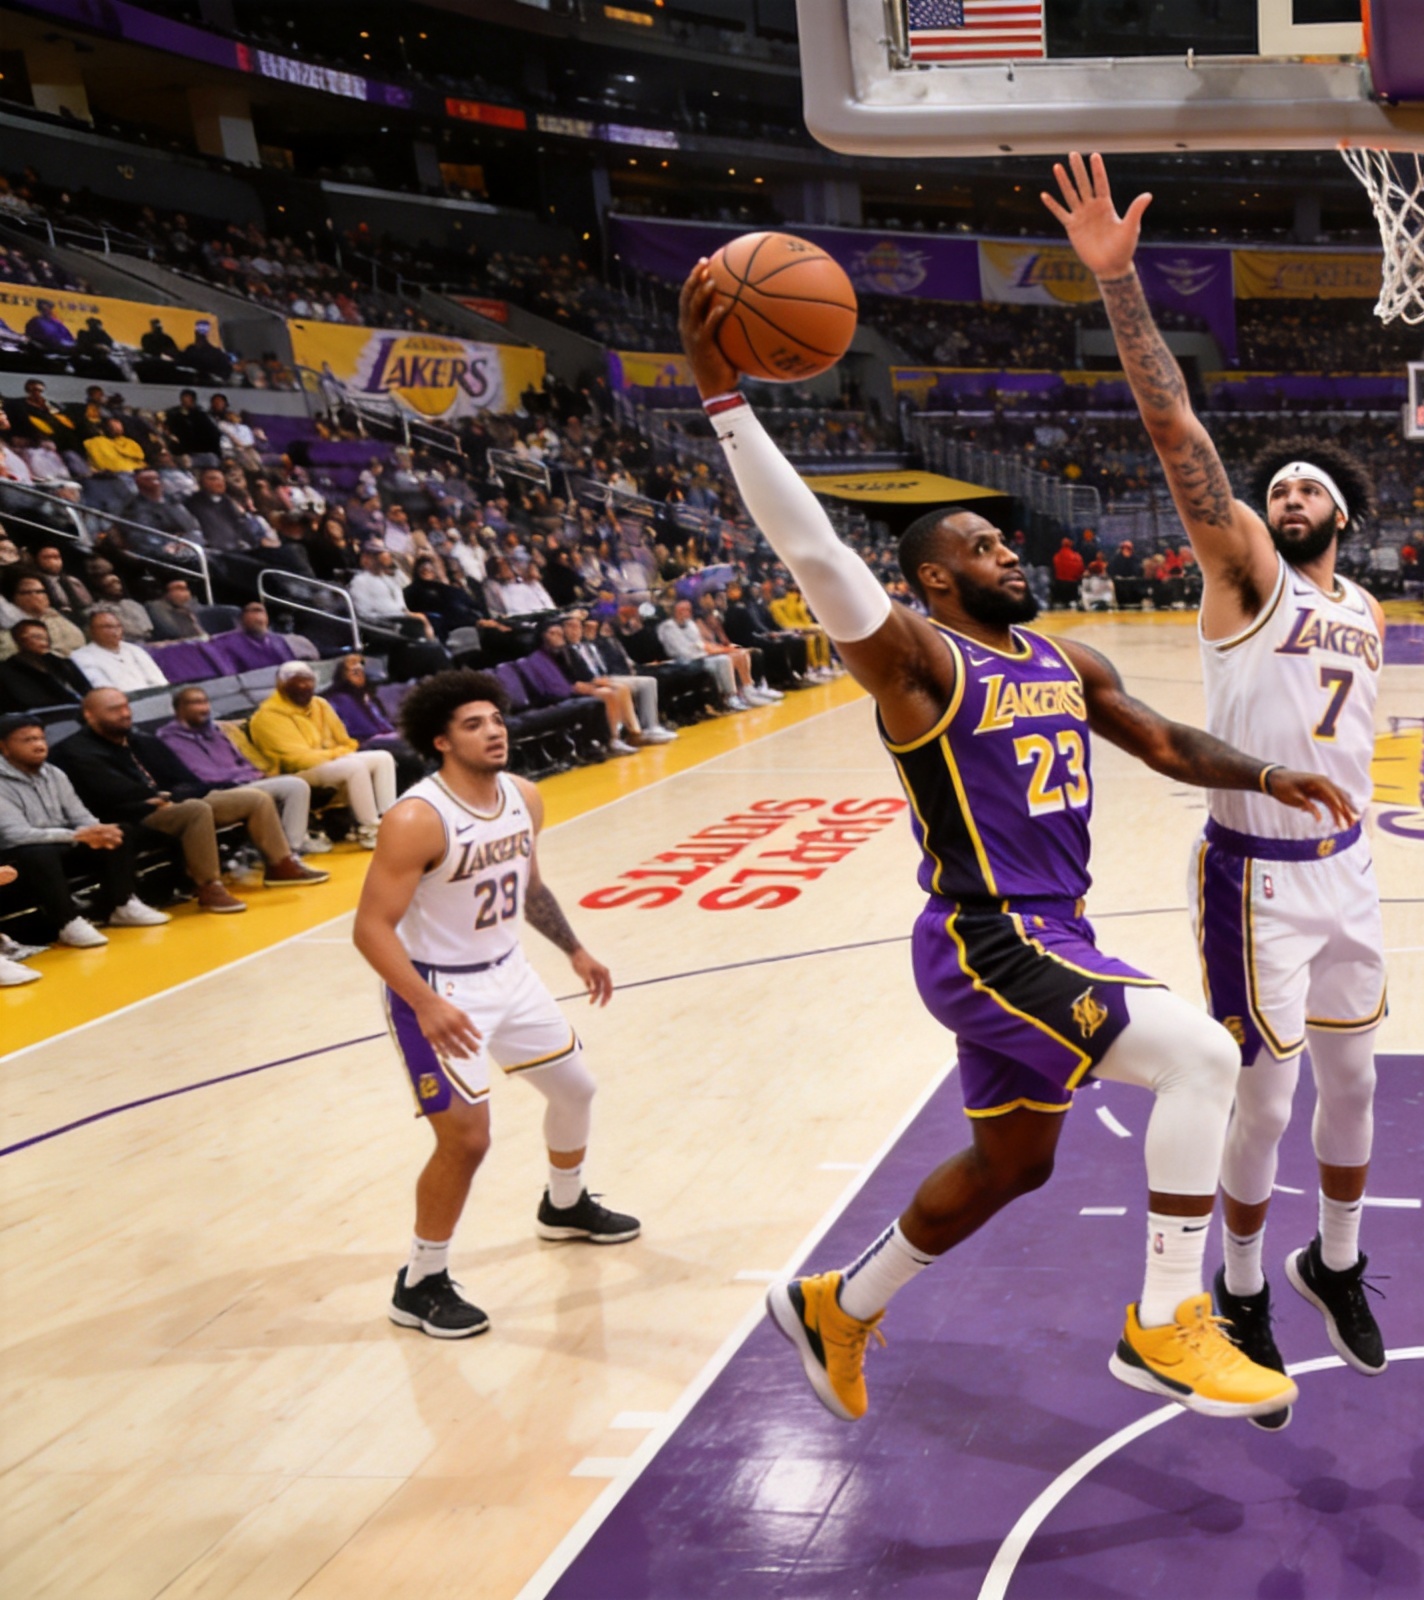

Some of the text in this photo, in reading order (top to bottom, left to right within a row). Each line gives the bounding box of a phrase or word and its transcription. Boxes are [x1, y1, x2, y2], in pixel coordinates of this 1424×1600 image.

[361, 337, 488, 398] LAKERS
[1274, 607, 1380, 672] LAKERS
[1312, 666, 1354, 742] 7
[1012, 729, 1090, 818] 23
